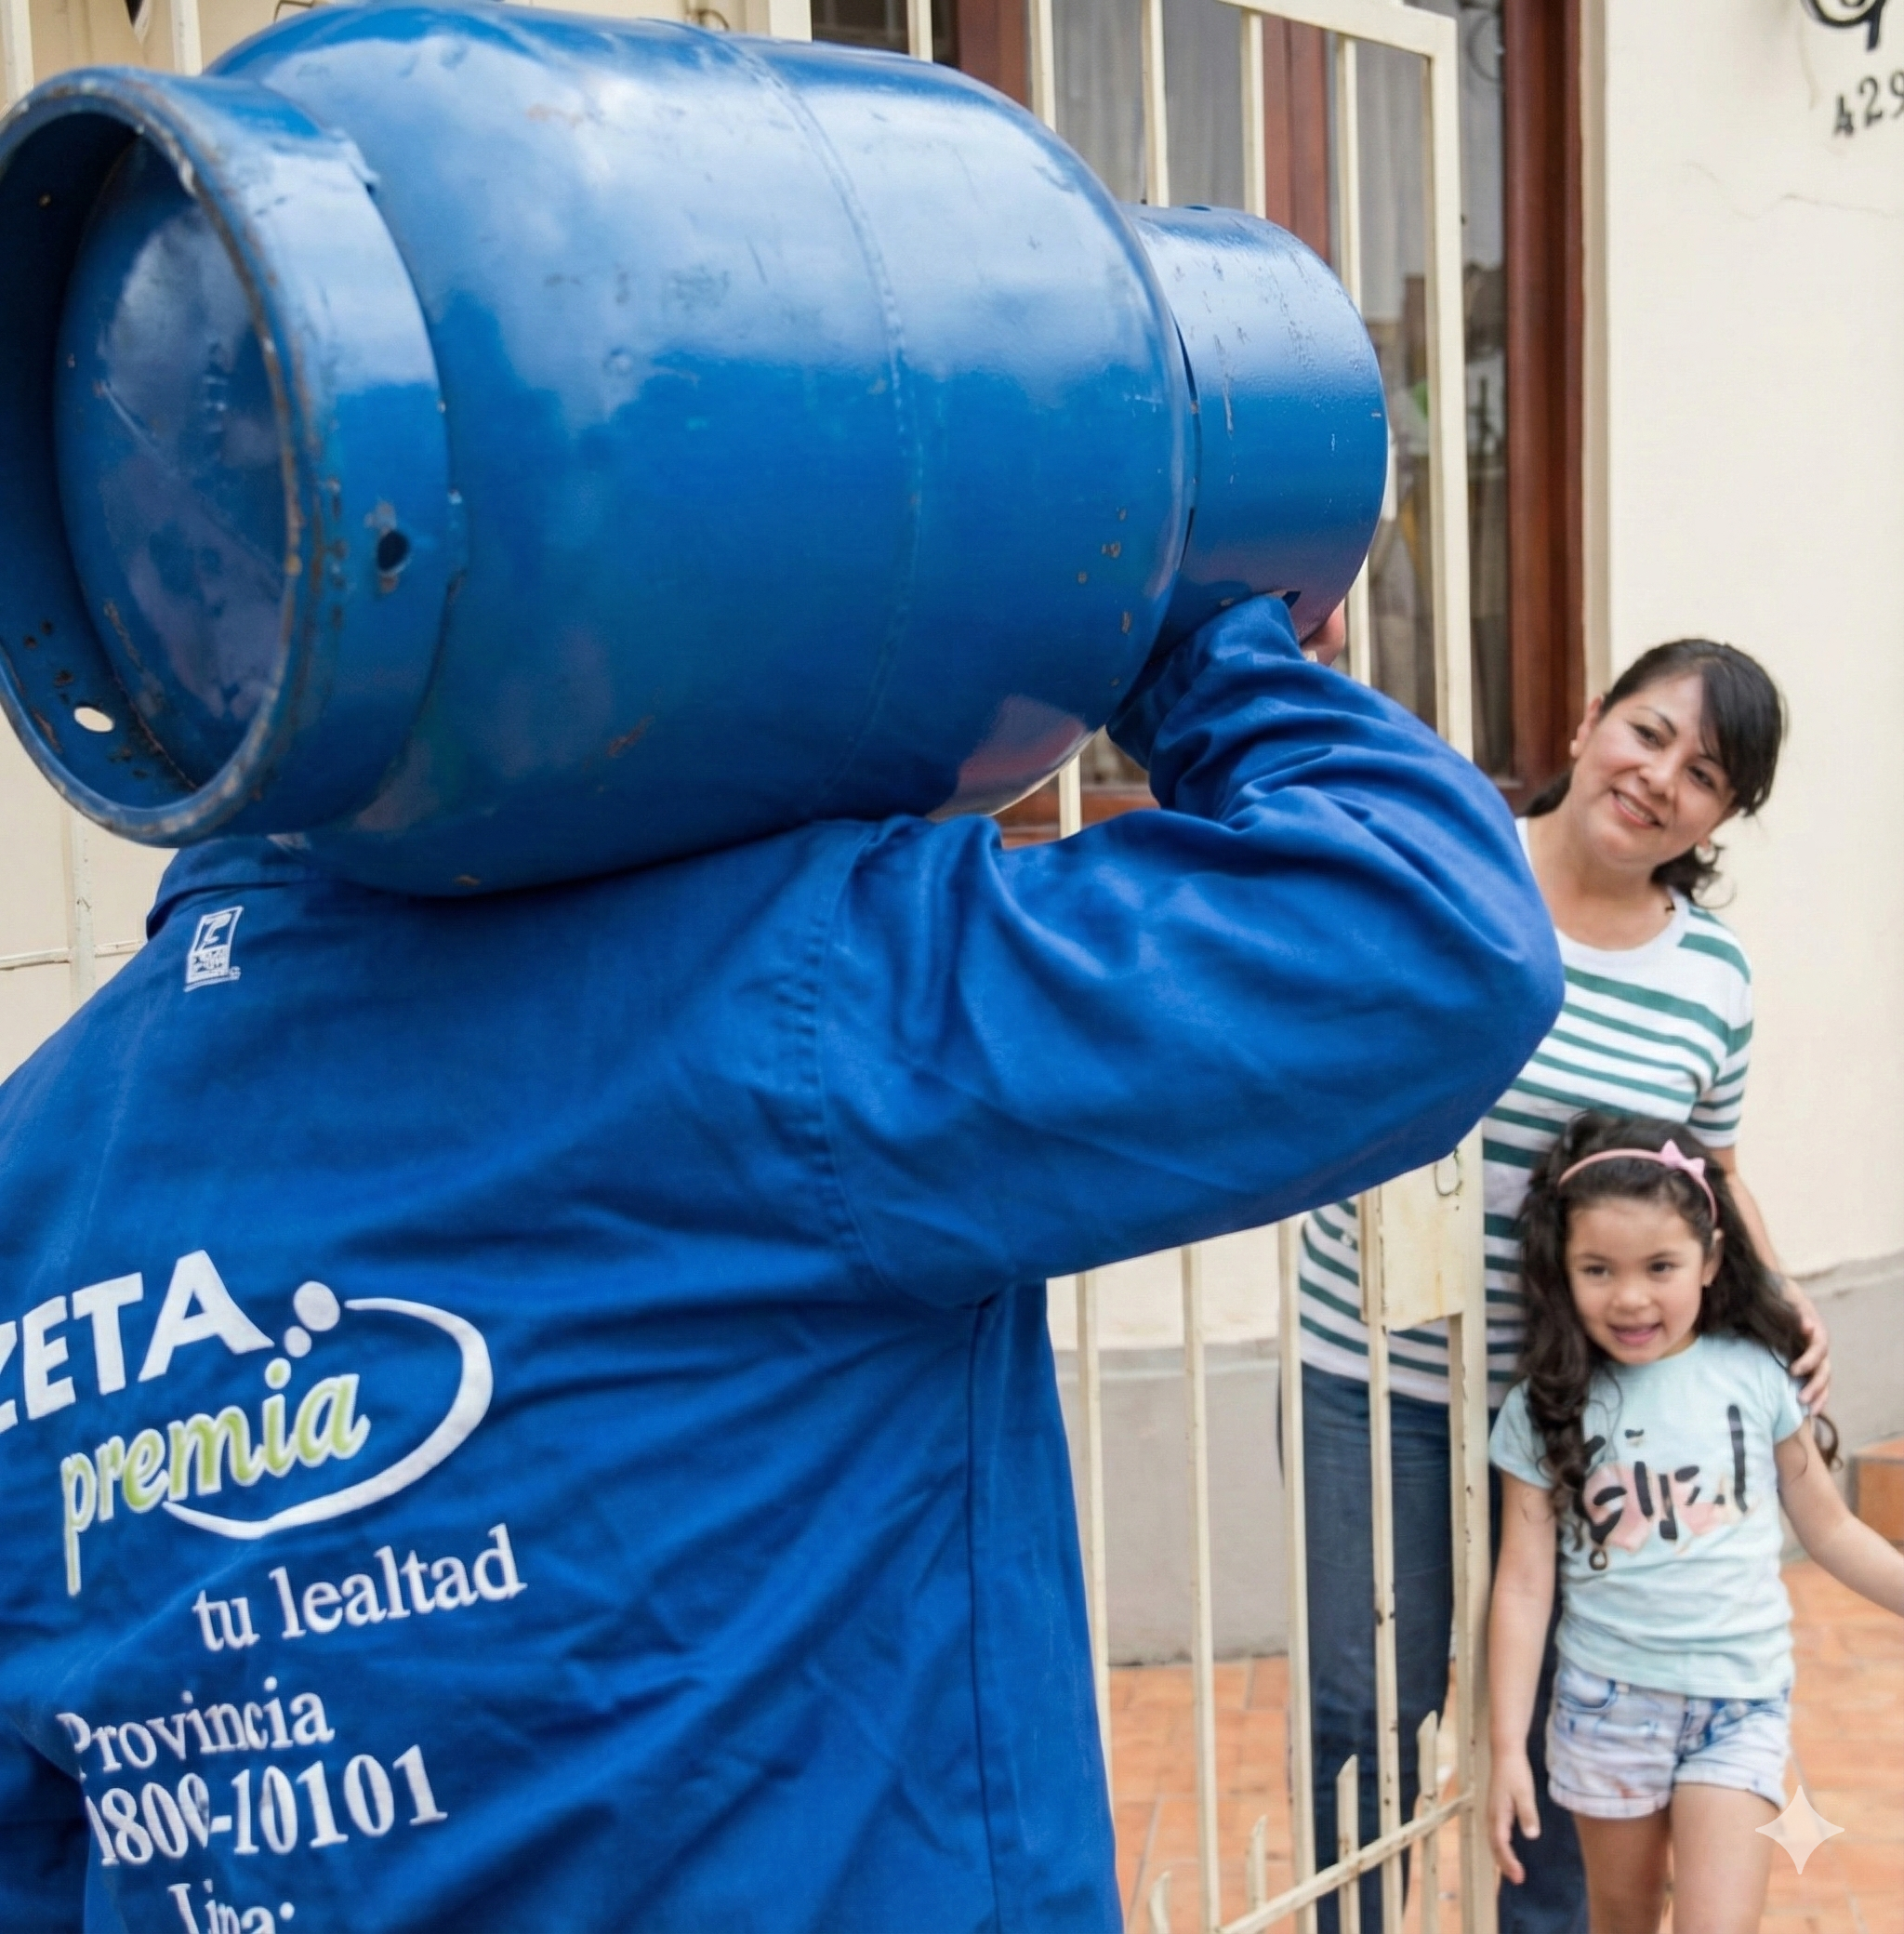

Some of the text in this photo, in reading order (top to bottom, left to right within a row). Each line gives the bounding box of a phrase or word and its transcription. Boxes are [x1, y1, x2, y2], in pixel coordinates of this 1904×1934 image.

[61, 1357, 371, 1597] premia
[192, 1523, 528, 1652] tu lealtad
